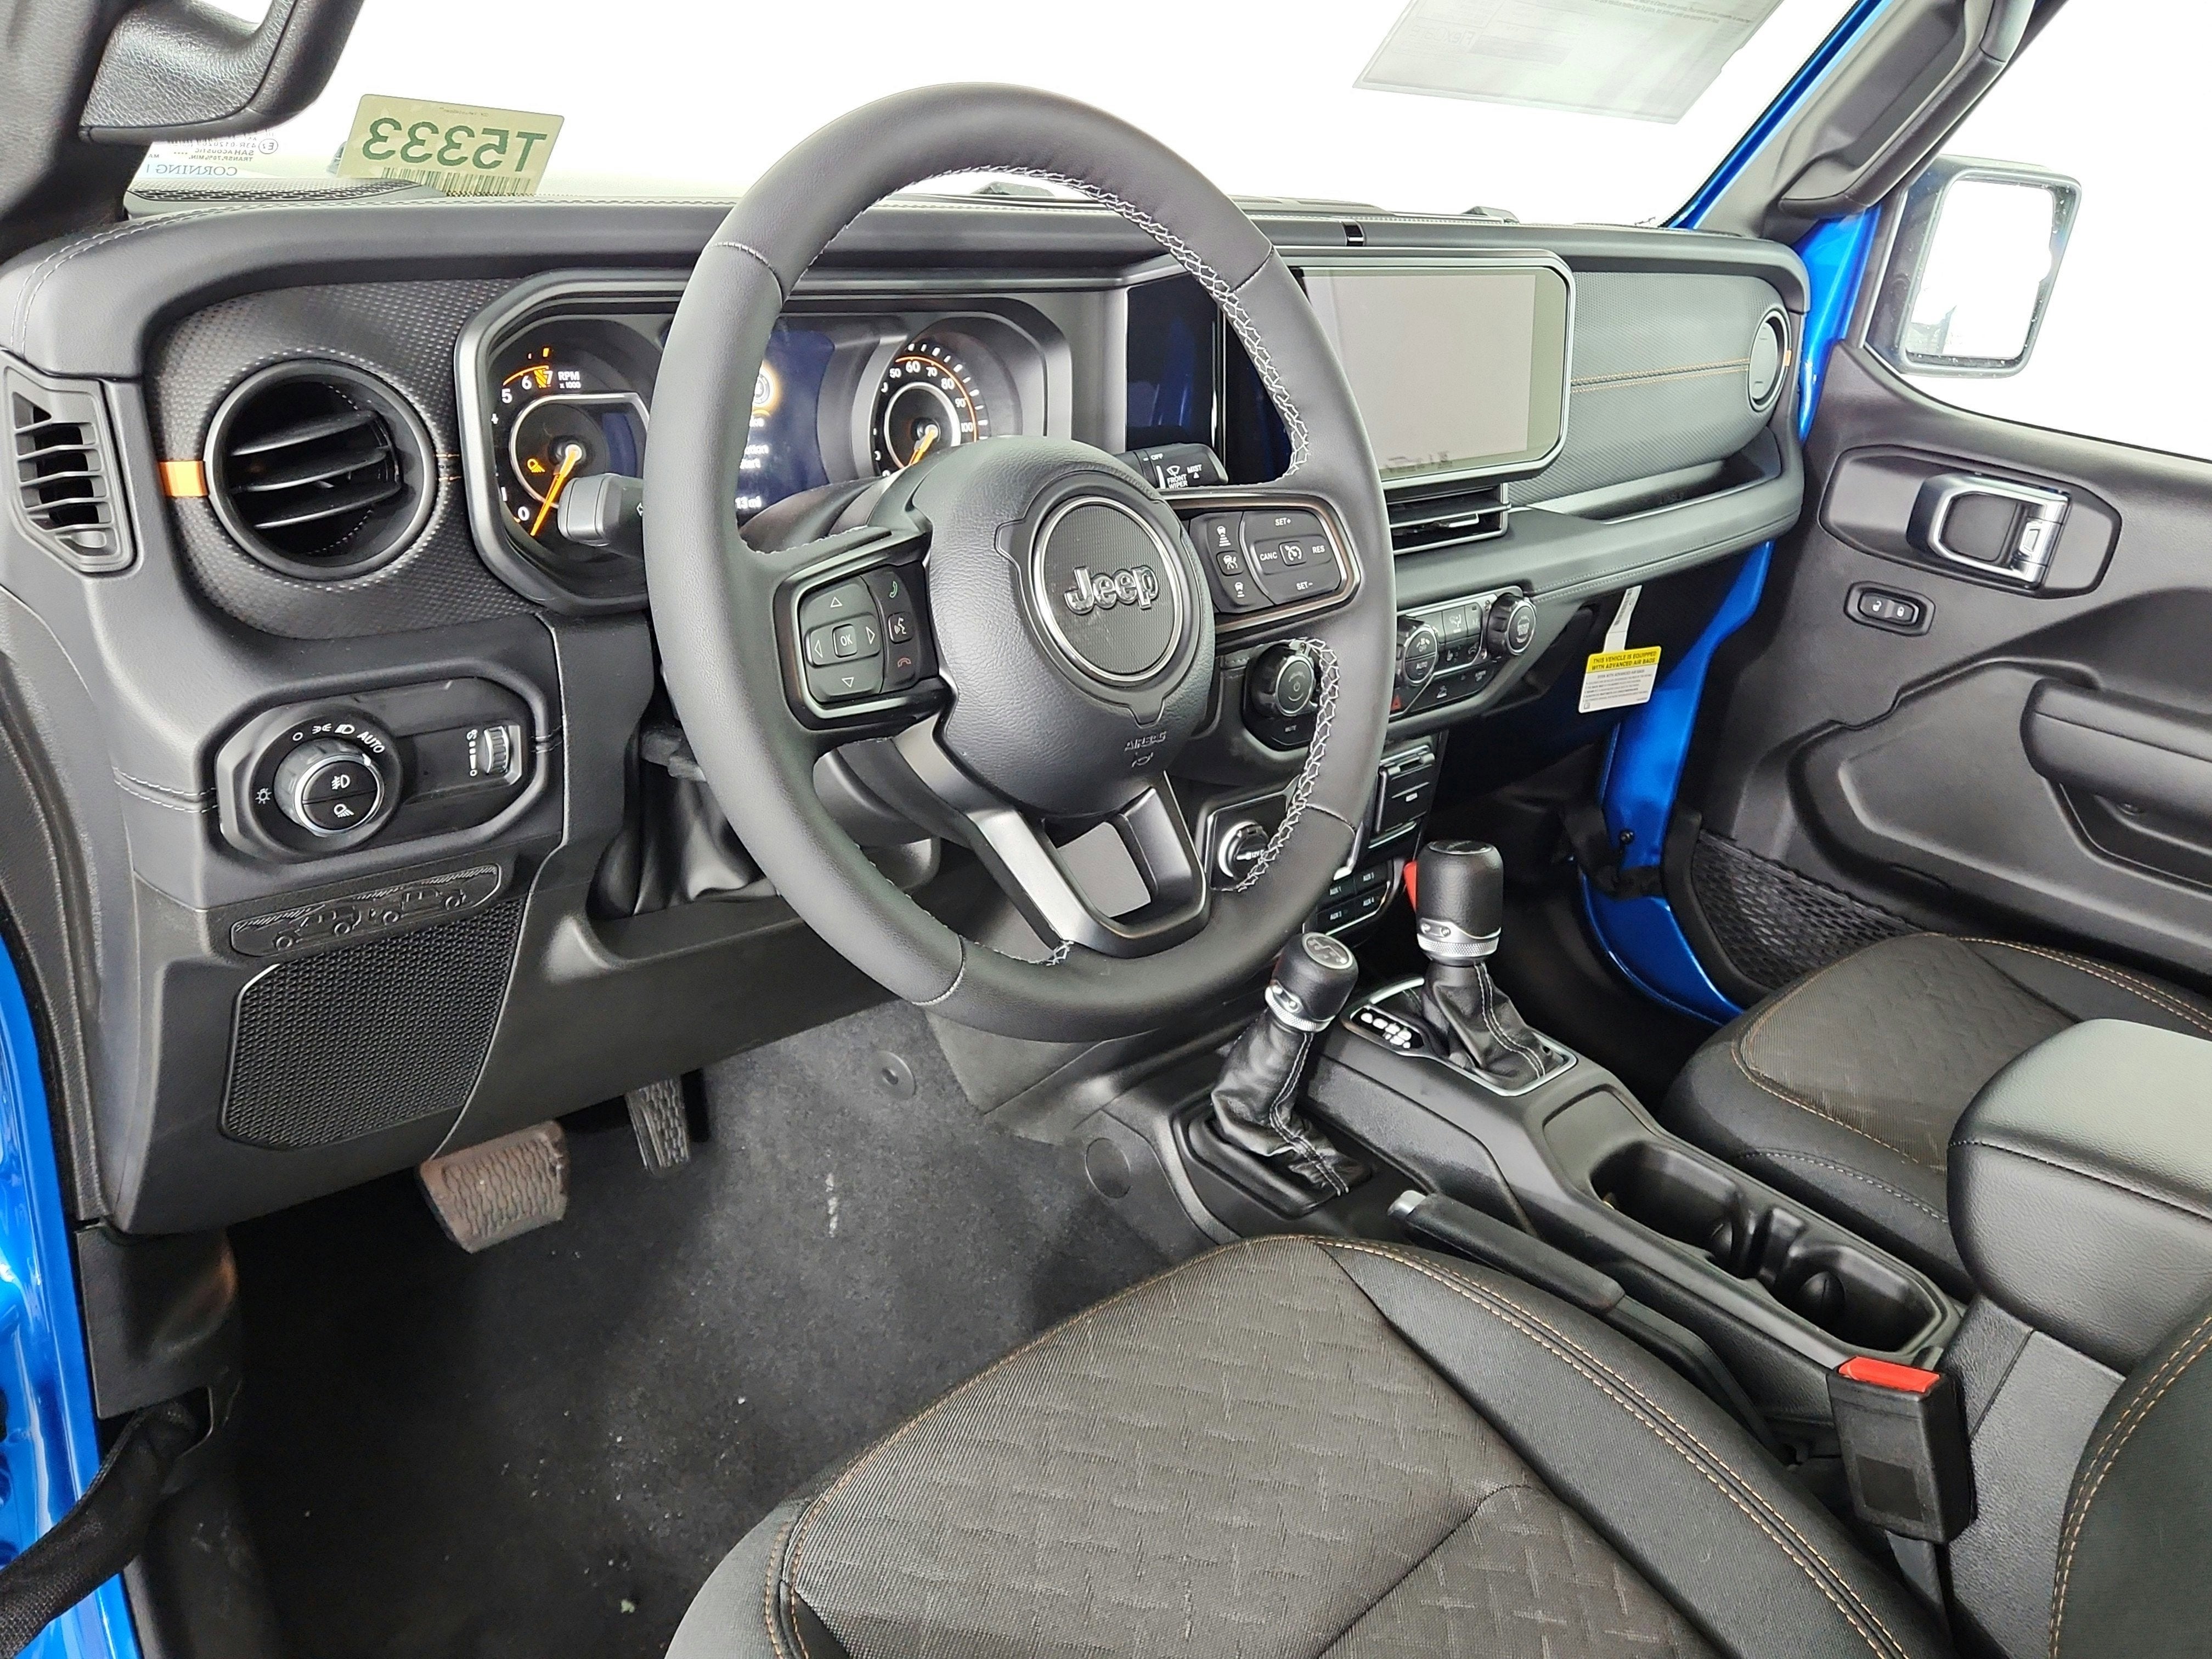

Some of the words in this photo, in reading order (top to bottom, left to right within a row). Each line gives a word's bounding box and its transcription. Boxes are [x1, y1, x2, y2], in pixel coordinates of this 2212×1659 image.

[906, 361, 920, 374] 60
[927, 366, 938, 377] 70
[543, 370, 553, 385] 7
[558, 371, 580, 381] RPM
[890, 368, 902, 379] 50
[522, 375, 532, 390] 6
[941, 379, 955, 390] 80
[501, 388, 512, 403] 5
[955, 397, 966, 408] 90
[961, 422, 974, 433] 100
[1187, 464, 1202, 473] MIST
[1167, 474, 1187, 483] FRONT
[1169, 481, 1188, 489] WIPER
[518, 506, 530, 521] 0
[1312, 545, 1325, 554] RES
[1260, 551, 1278, 561] CANC
[1064, 566, 1159, 614] Jeep
[840, 634, 853, 646] OK
[1633, 651, 1657, 659] EQUIPPED
[357, 731, 385, 753] AUTO
